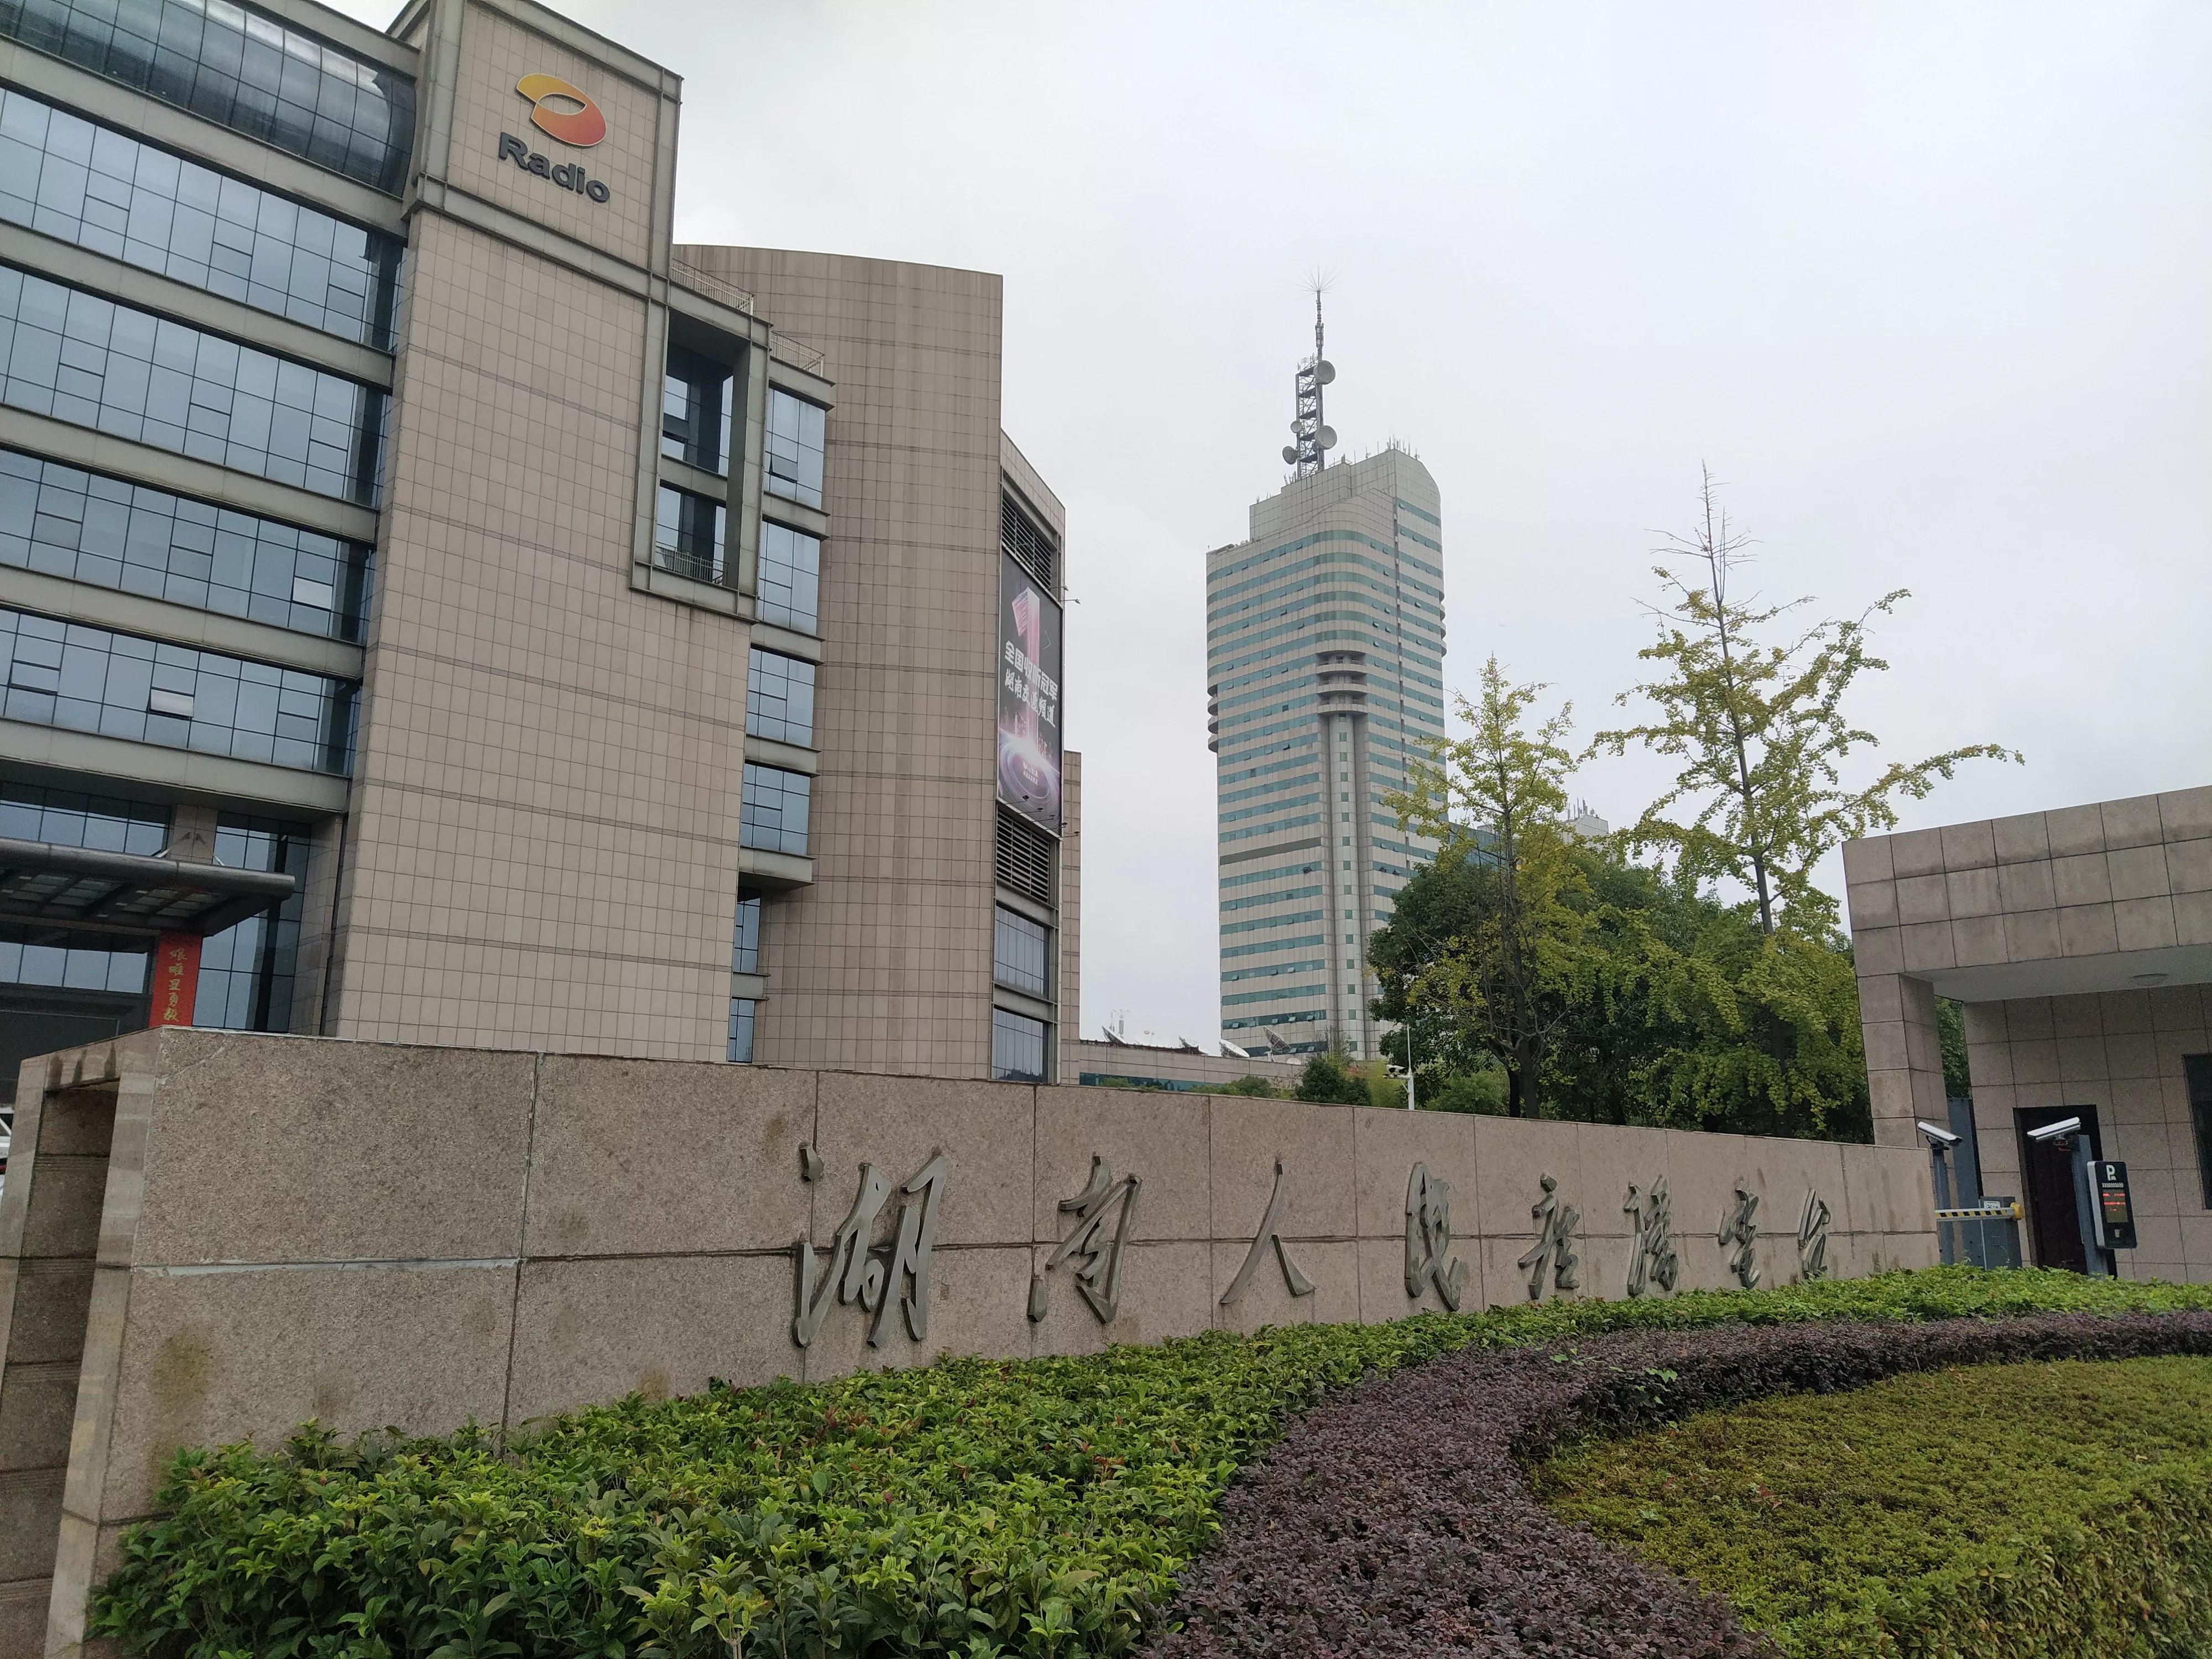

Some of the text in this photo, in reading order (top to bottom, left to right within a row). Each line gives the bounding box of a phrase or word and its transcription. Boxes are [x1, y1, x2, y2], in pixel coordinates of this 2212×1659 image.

[499, 132, 610, 203] Radio
[1004, 640, 1058, 701] 全国收听冠军
[2106, 1164, 2116, 1181] P
